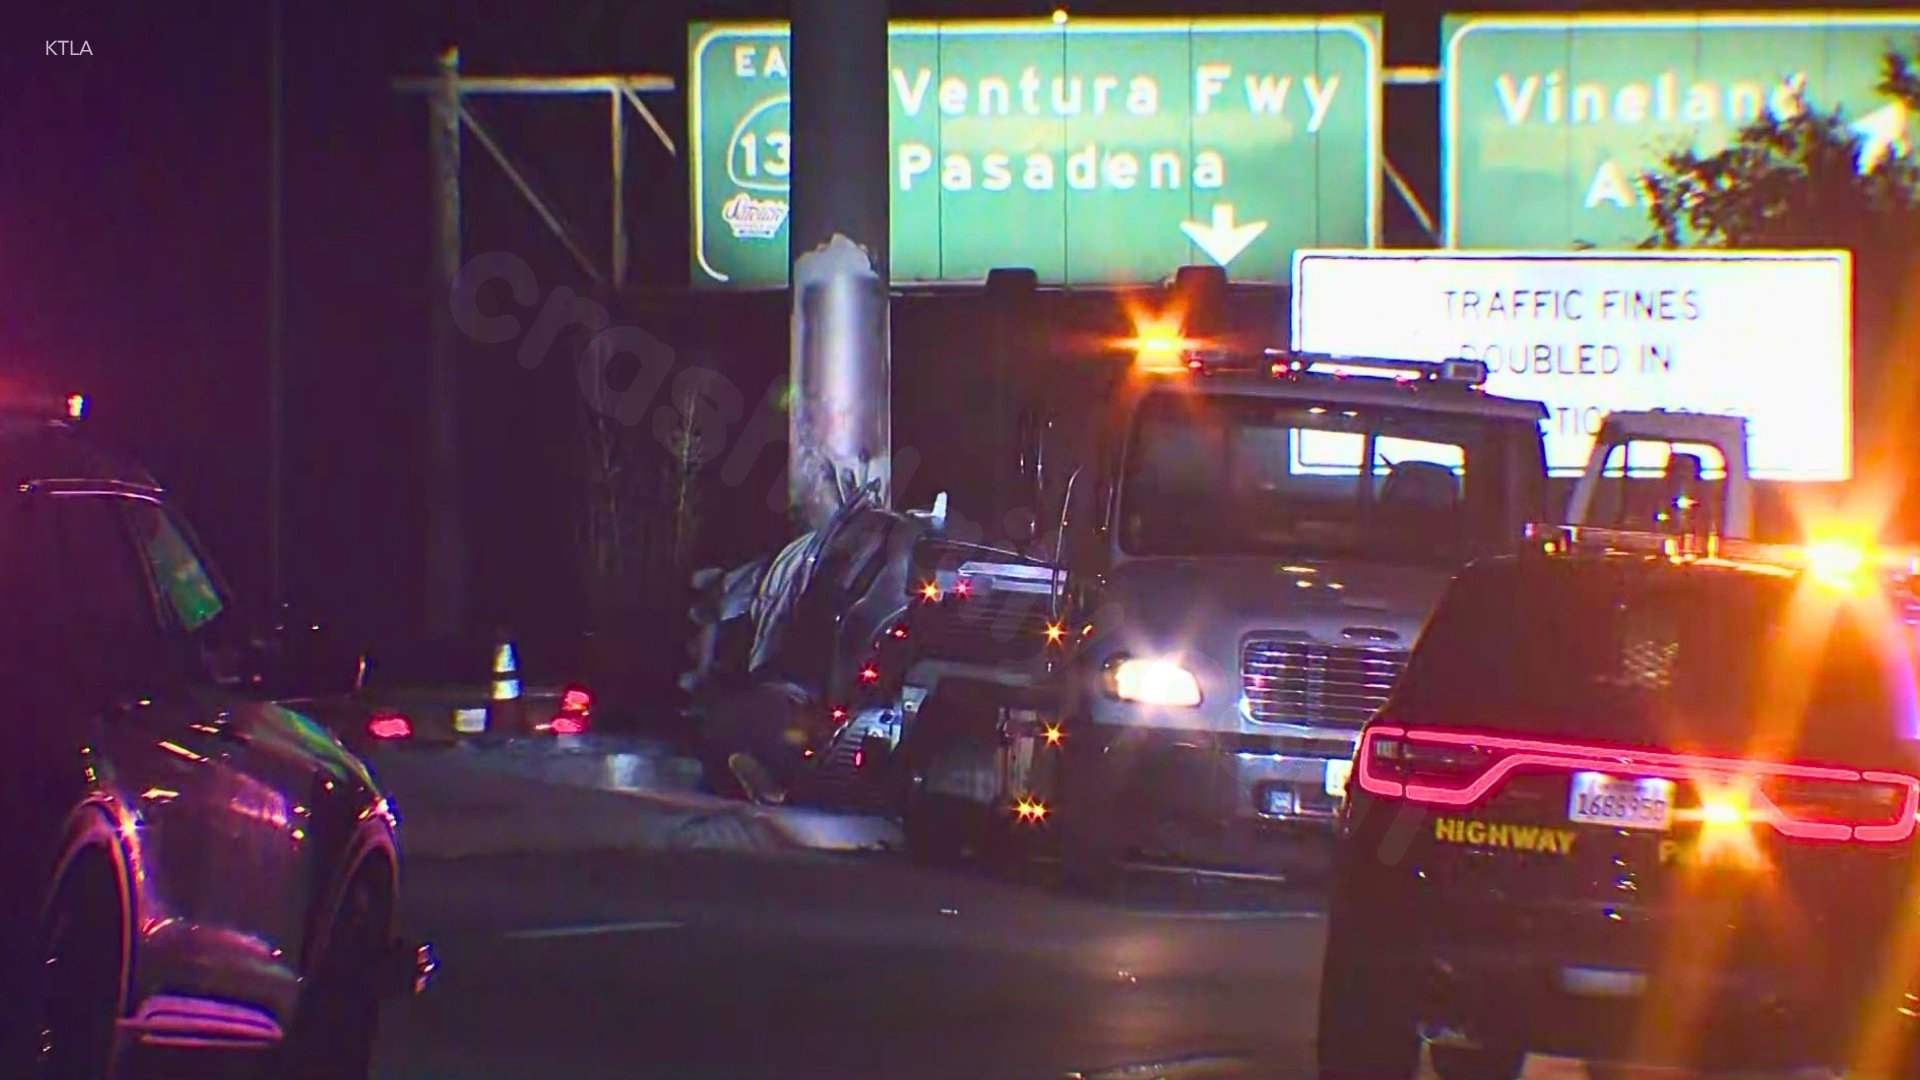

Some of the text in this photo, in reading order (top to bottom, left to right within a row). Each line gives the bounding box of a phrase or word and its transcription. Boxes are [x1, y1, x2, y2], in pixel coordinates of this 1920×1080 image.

[734, 45, 789, 78] EA
[892, 65, 1340, 133] Ventura Fwy
[899, 143, 1226, 192] Pasadena
[1442, 289, 1701, 321] TRAFFIC FINES
[1640, 344, 1673, 375] IN
[1434, 816, 1577, 856] HIGHWAY
